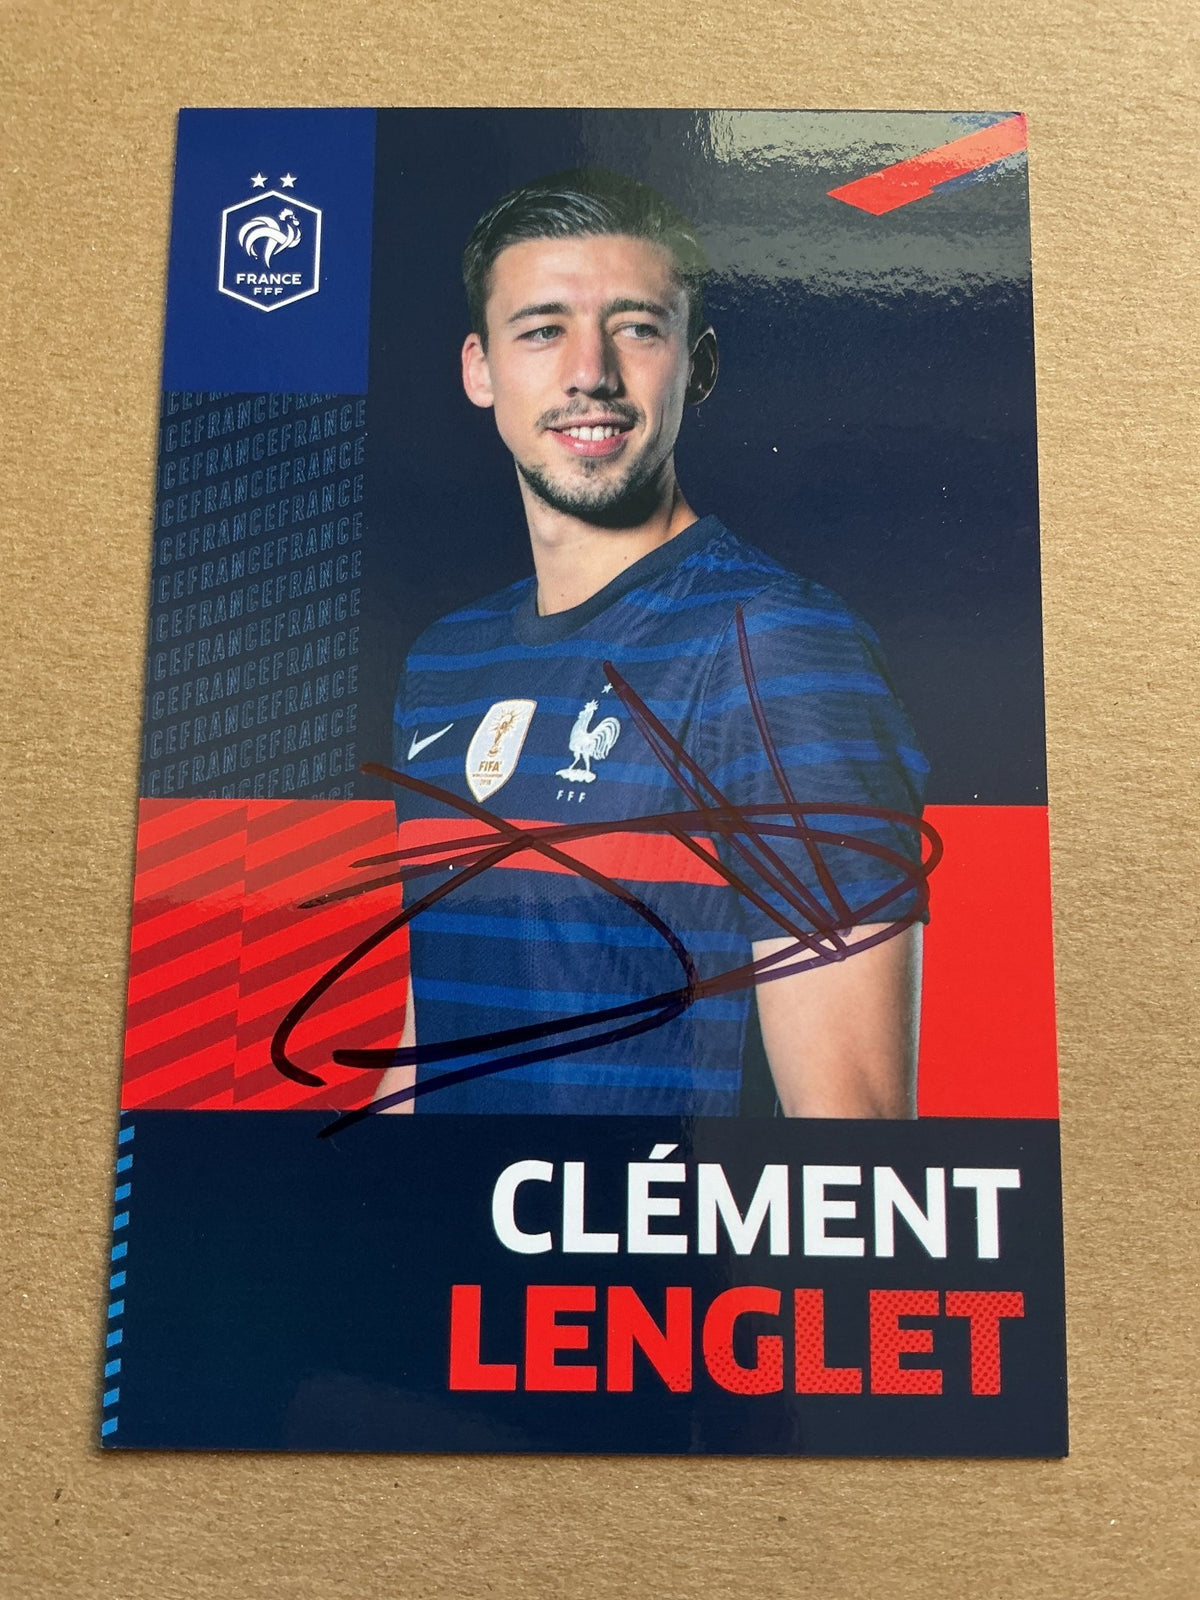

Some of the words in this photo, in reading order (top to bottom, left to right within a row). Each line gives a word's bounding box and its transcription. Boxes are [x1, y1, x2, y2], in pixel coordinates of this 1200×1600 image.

[236, 273, 302, 285] FRANCE
[253, 287, 284, 296] FFF
[155, 437, 365, 529] CEFRANCEFRANCE
[158, 400, 366, 491] CEFRANCEFRANCE
[151, 512, 363, 604] CEFRANCEFRANCE
[153, 474, 364, 567] CEFRANCEFRANCE
[147, 588, 361, 682] CEFRANCEFRANCE
[149, 550, 362, 643] CEFRANCEFRANCE
[142, 665, 359, 760] CEFRANCEFRANCE
[145, 627, 360, 721] CEFRANCEFRANCE
[479, 761, 500, 772] FIFA
[556, 789, 586, 804] FFF
[491, 1143, 1021, 1259] CLÉMENT
[449, 1284, 1025, 1396] LENGLET
